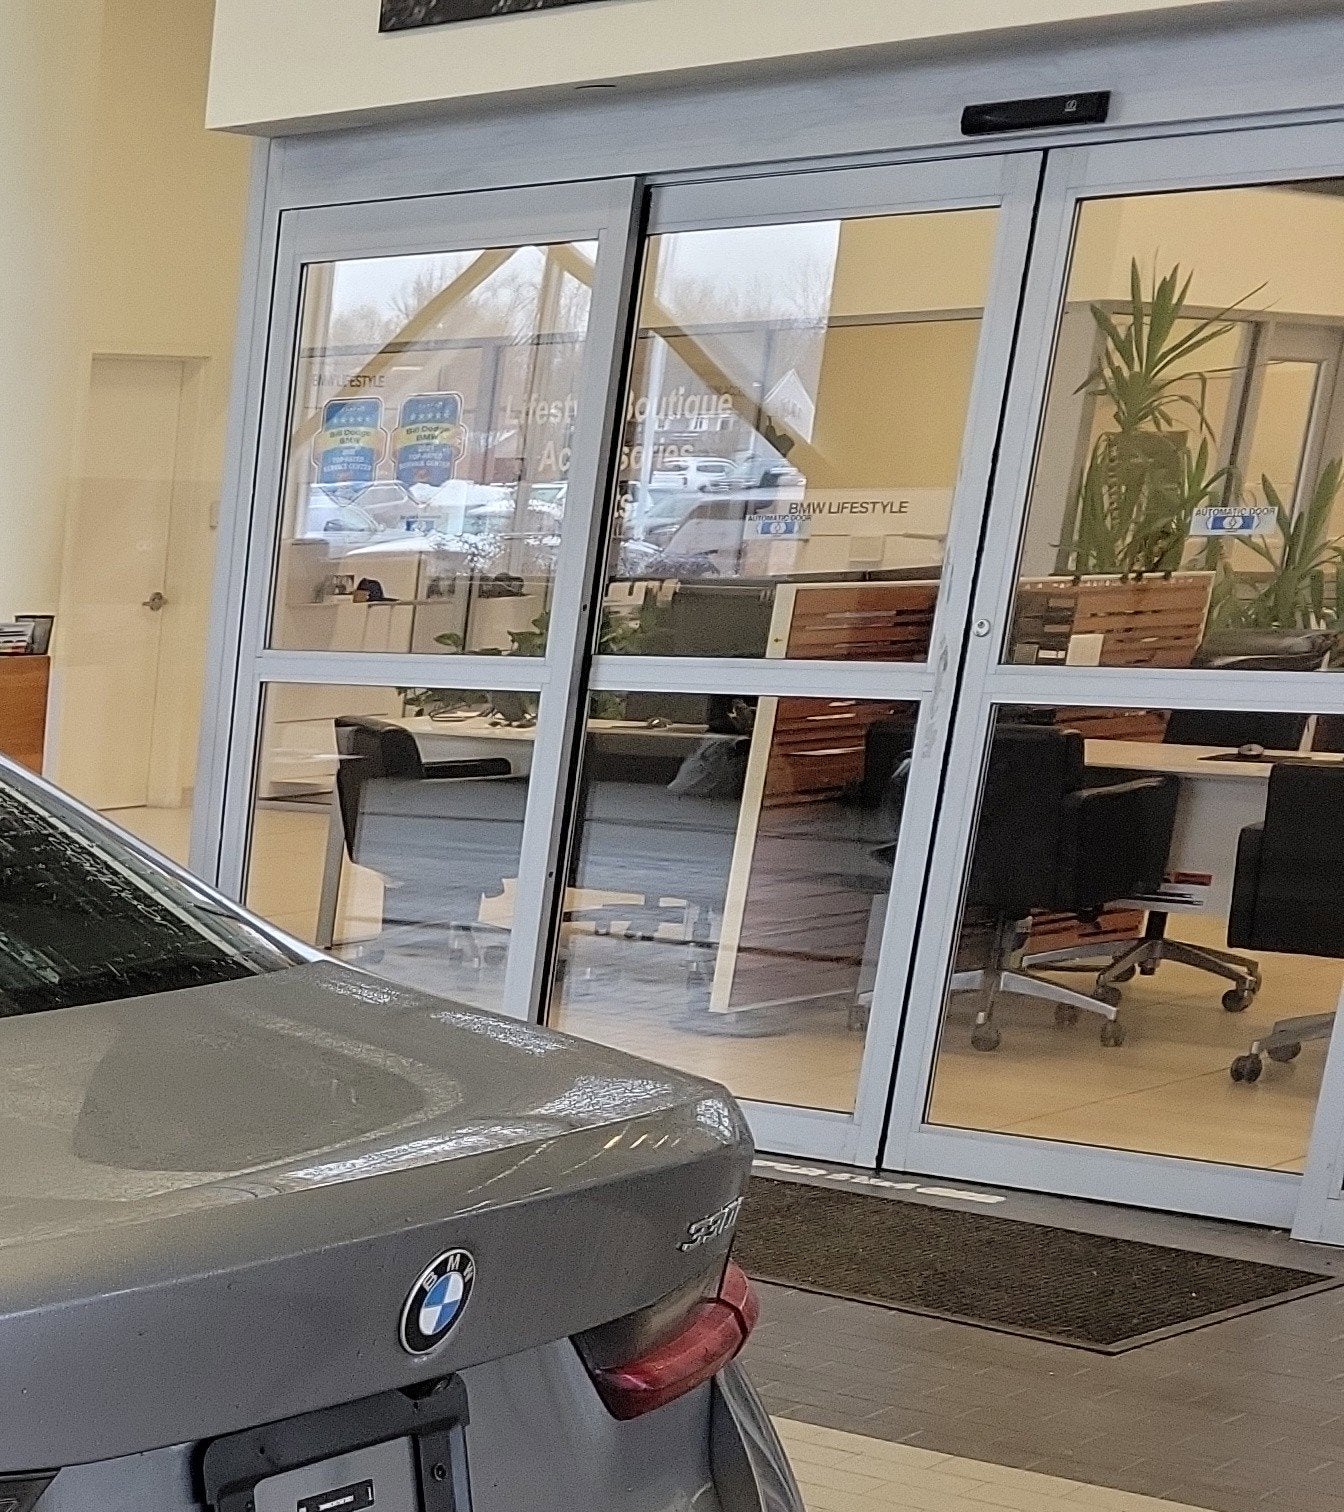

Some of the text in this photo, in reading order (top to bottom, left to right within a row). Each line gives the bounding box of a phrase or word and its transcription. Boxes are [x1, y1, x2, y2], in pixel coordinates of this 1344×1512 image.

[789, 500, 910, 515] BMW LIFESTYLE
[1194, 507, 1276, 517] AUTOMATIC DOOR
[422, 1253, 474, 1292] BMW
